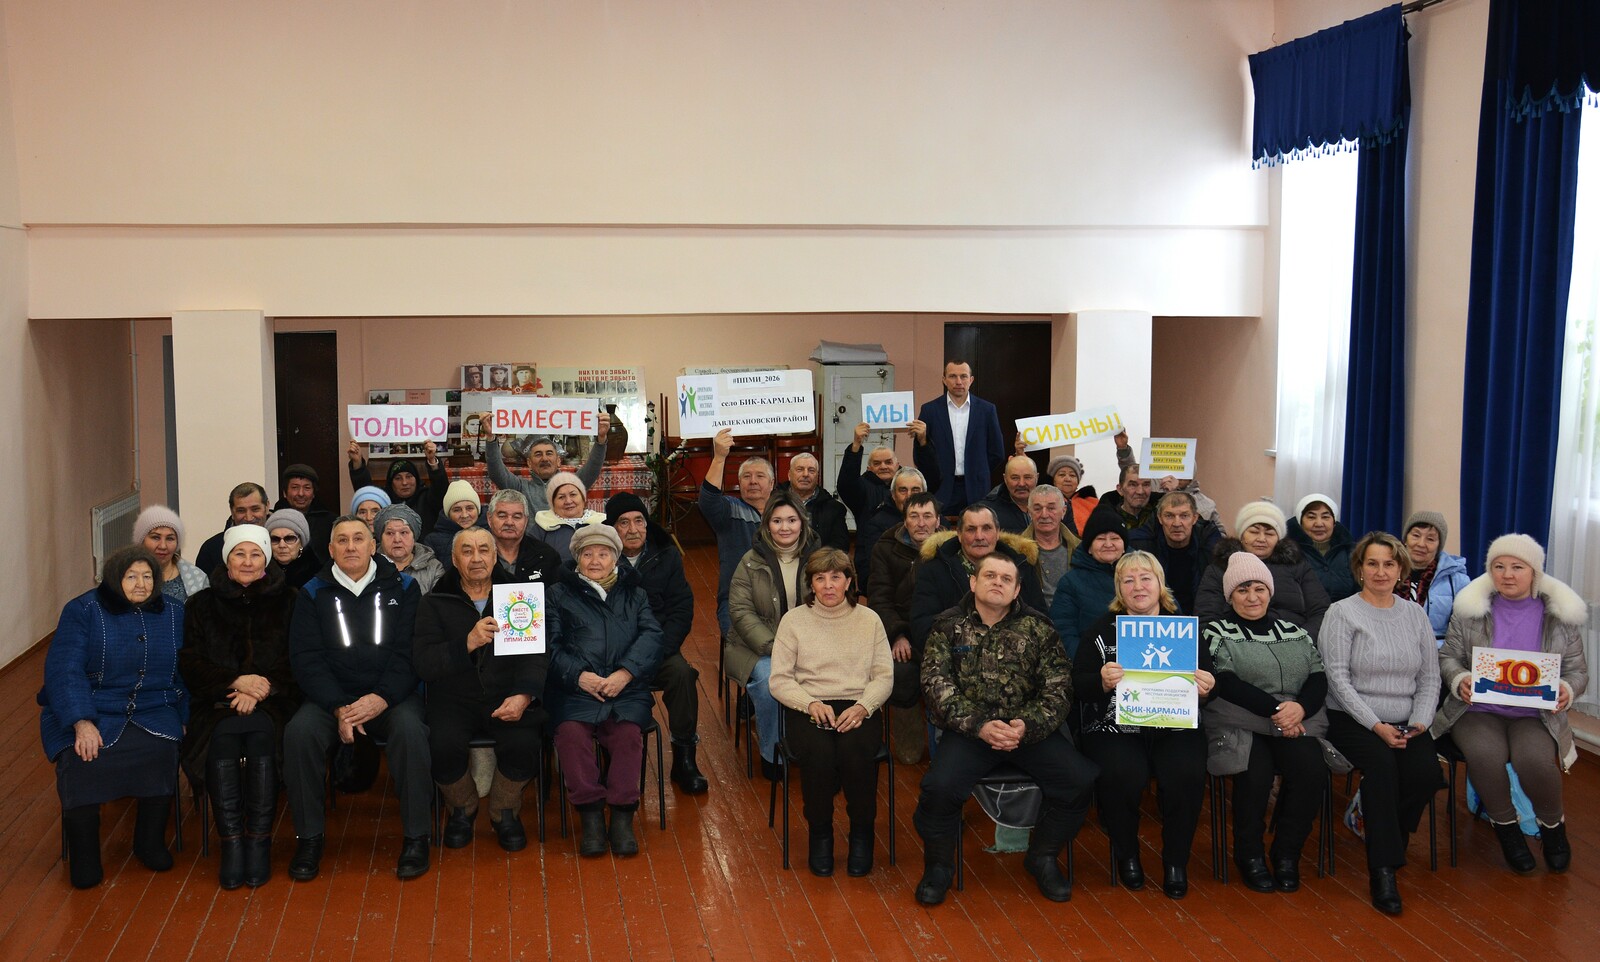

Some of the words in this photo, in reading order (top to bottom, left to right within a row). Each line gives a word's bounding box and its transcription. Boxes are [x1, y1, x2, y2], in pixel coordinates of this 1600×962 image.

[732, 375, 780, 385] #ППМИ_2026
[739, 396, 805, 406] БИК-КАРМАЛЫ
[496, 409, 592, 430] ВМЕСТЕ
[711, 416, 781, 428] ДАВЛЕКАНОВСКИЙ
[782, 415, 808, 423] РАЙОН
[866, 403, 908, 423] МЫ
[350, 416, 447, 437] ТОЛЬКО
[1022, 412, 1122, 446] СИЛЬНЫ!
[1121, 620, 1193, 639] ППМИ
[1495, 659, 1541, 687] 10
[1511, 687, 1543, 695] ВМЕСТЕ
[1126, 705, 1190, 715] БИК-КАРМАЛЫ
